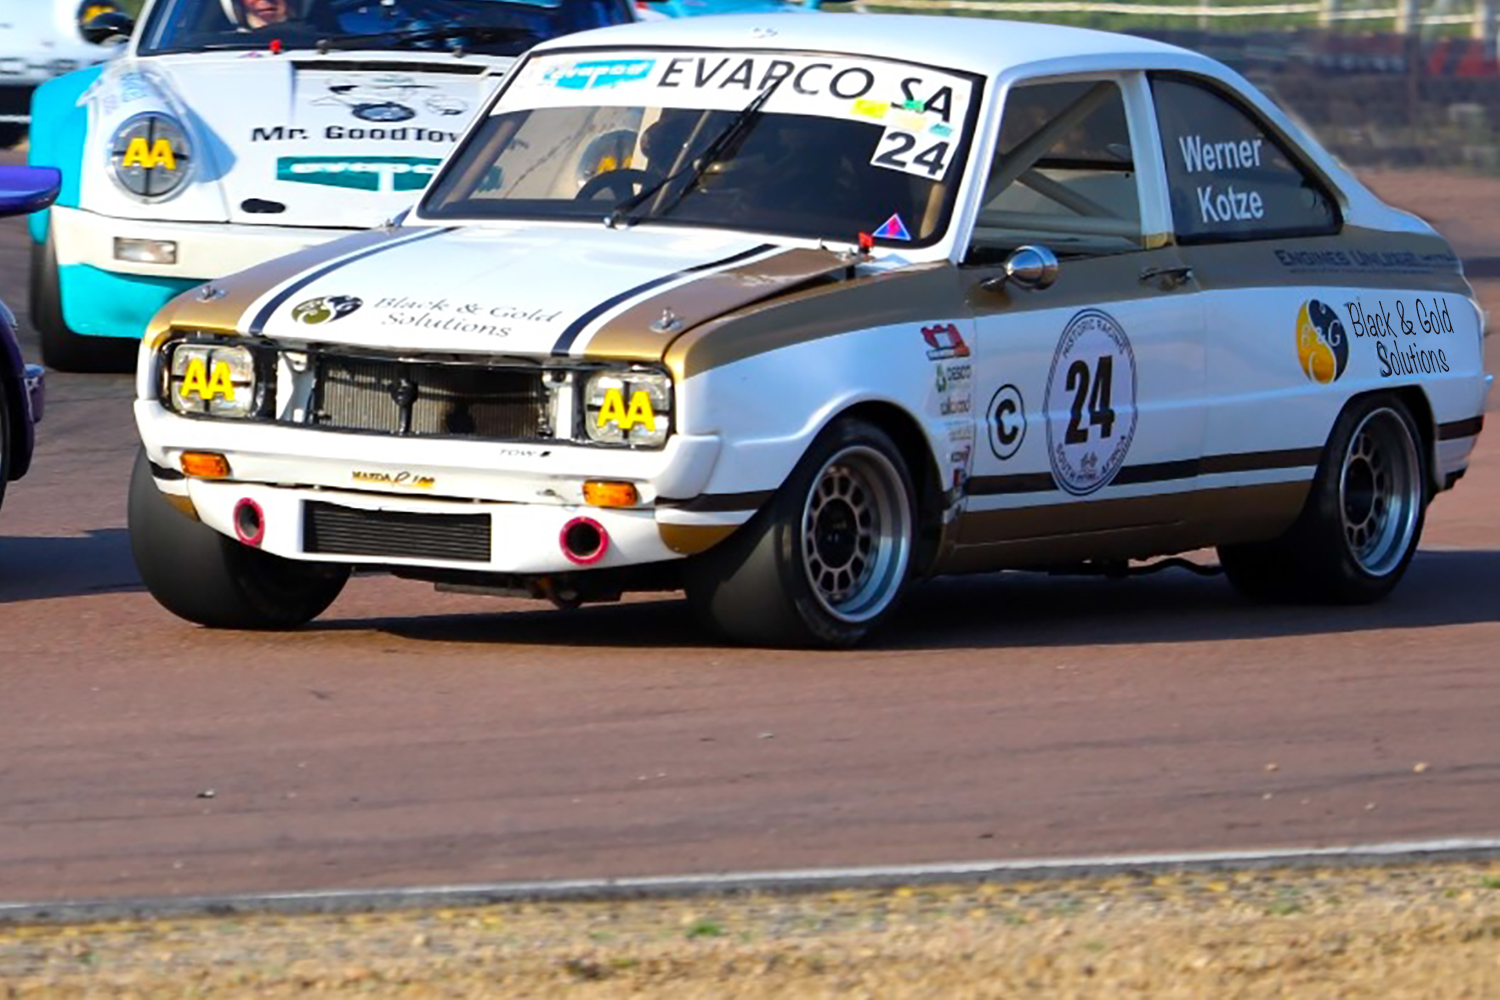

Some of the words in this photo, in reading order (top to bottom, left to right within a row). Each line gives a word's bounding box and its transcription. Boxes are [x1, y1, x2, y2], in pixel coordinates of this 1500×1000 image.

[656, 58, 875, 100] EVAPCO
[891, 77, 953, 123] SA
[122, 137, 177, 171] AA
[250, 126, 308, 142] Mr.
[873, 131, 950, 176] 24
[1178, 135, 1262, 173] Werner
[1196, 185, 1264, 223] Kotze
[373, 296, 450, 312] Black
[456, 301, 484, 314] &
[489, 307, 563, 323] Gold
[381, 312, 513, 338] Solutions
[1346, 300, 1398, 338] Black
[1395, 300, 1417, 336] &
[1415, 298, 1455, 335] Gold
[1062, 318, 1095, 359] HISTORIC
[1376, 339, 1450, 378] Solutions
[180, 358, 235, 403] AA
[1064, 355, 1116, 445] 24
[597, 387, 656, 433] AA
[1056, 442, 1080, 483] SOUTH
